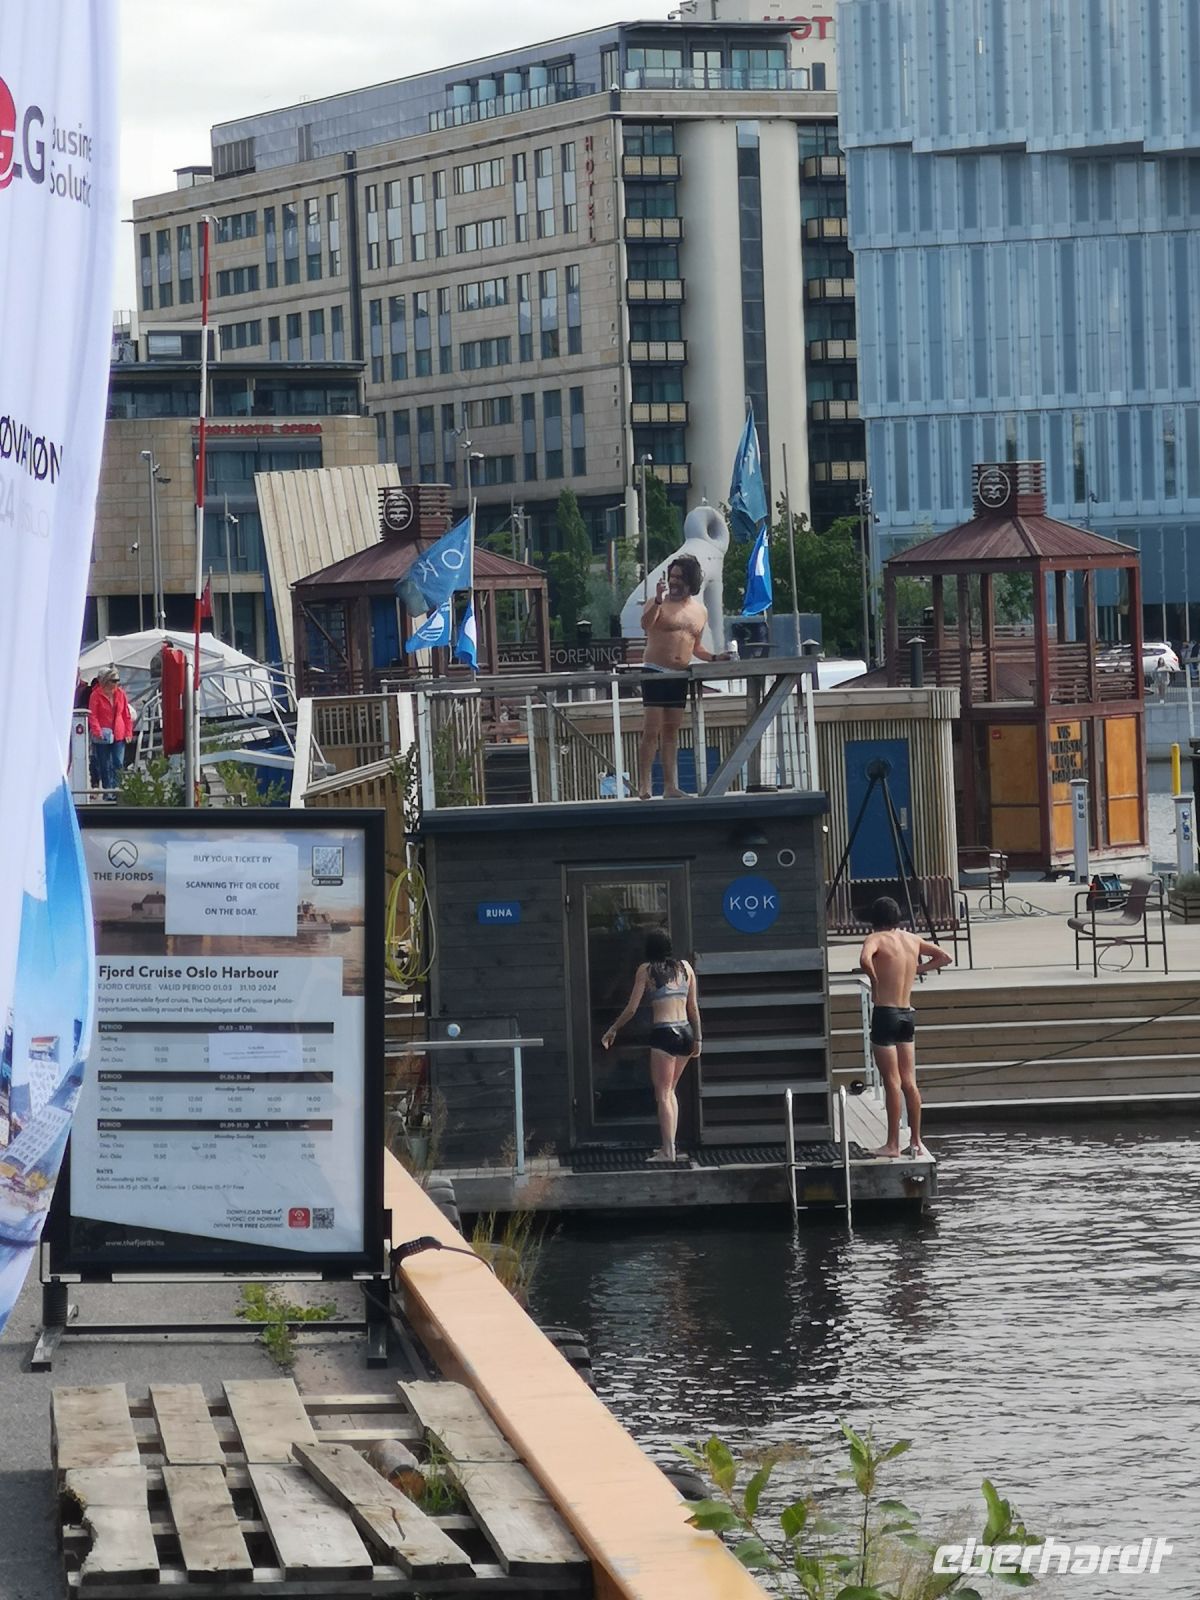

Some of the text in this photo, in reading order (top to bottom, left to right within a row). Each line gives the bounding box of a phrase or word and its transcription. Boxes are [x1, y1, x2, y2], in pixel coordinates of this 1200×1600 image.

[193, 855, 209, 863] BUY
[210, 855, 232, 863] YOUR
[234, 855, 260, 864] TICKET
[93, 872, 153, 881] THE FJORDS
[185, 881, 227, 889] SCANNING
[730, 896, 775, 910] KOK
[486, 908, 512, 918] RUNA
[99, 965, 279, 980] Fjord Cruise Oslo Harbour
